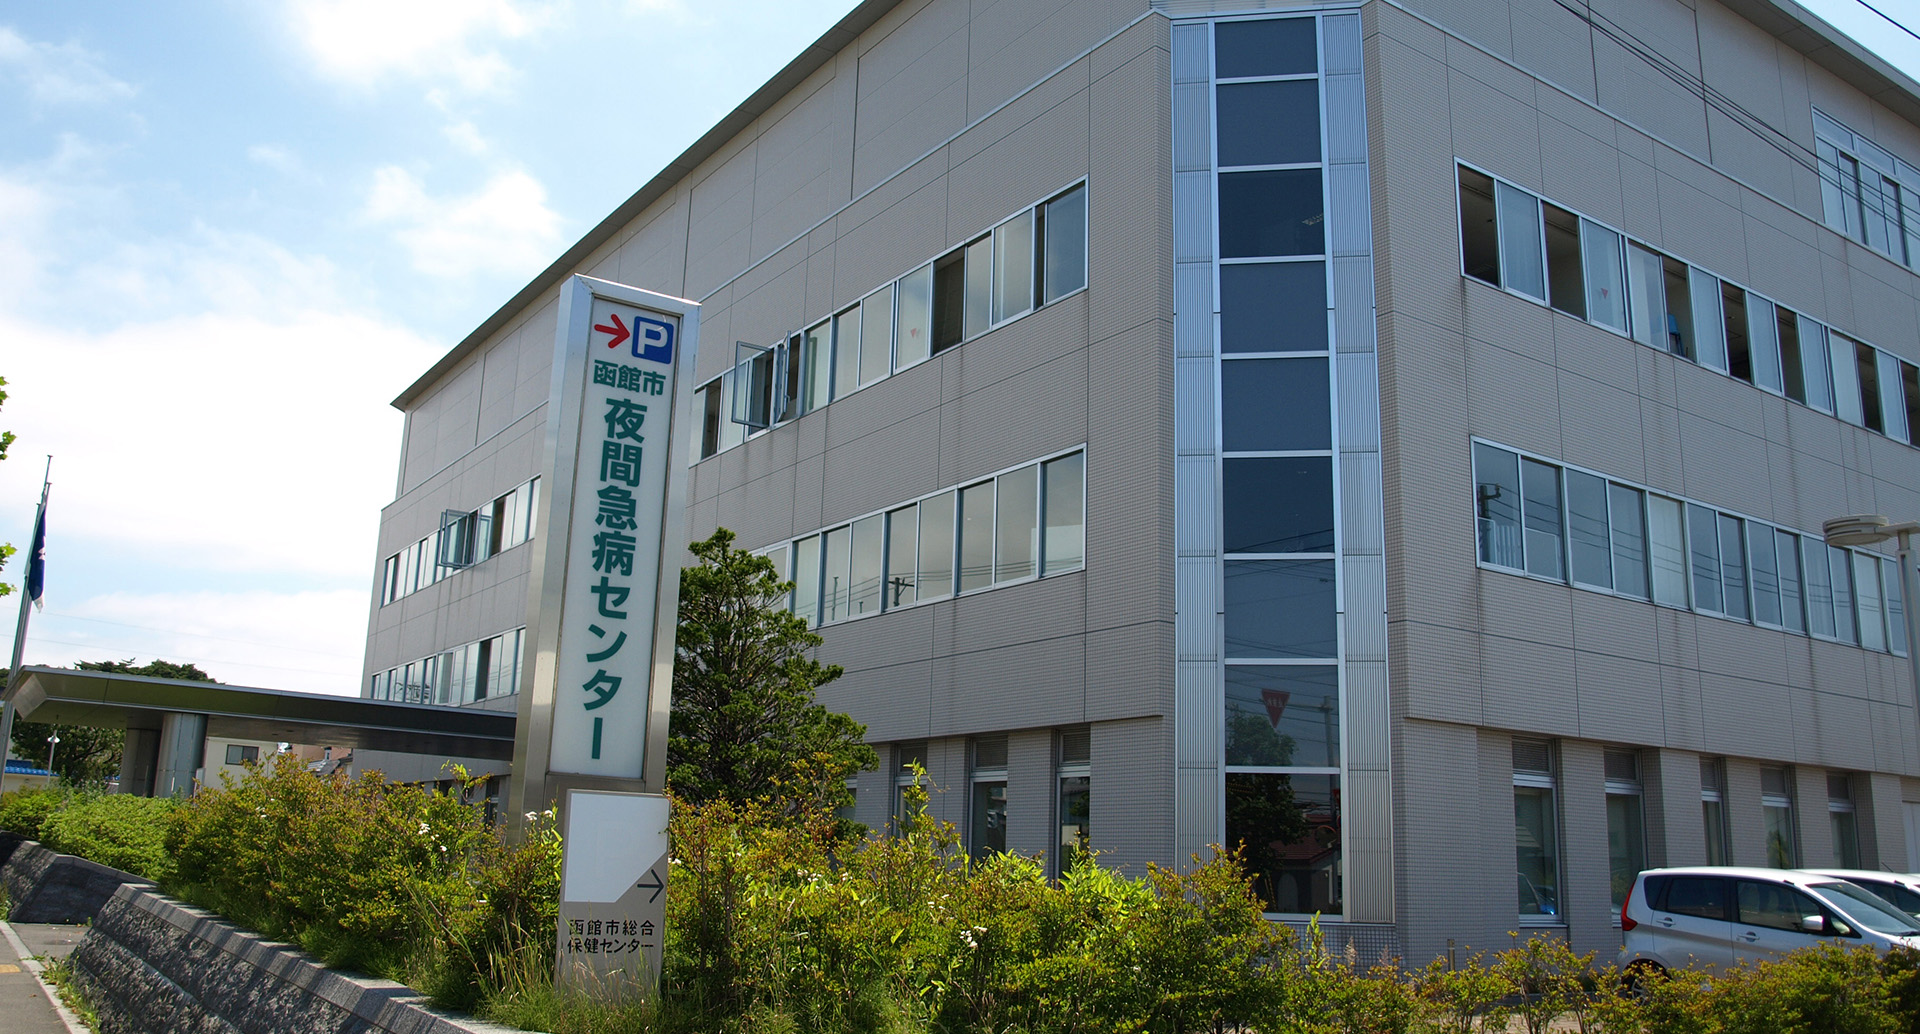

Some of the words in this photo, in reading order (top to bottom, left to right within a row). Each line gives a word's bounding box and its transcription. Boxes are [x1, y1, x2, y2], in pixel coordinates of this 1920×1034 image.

[637, 322, 669, 357] P
[593, 359, 667, 397] 函館市
[582, 398, 648, 760] 夜間急病センター
[568, 919, 655, 936] 函館市総合
[567, 937, 654, 954] 保健センター
